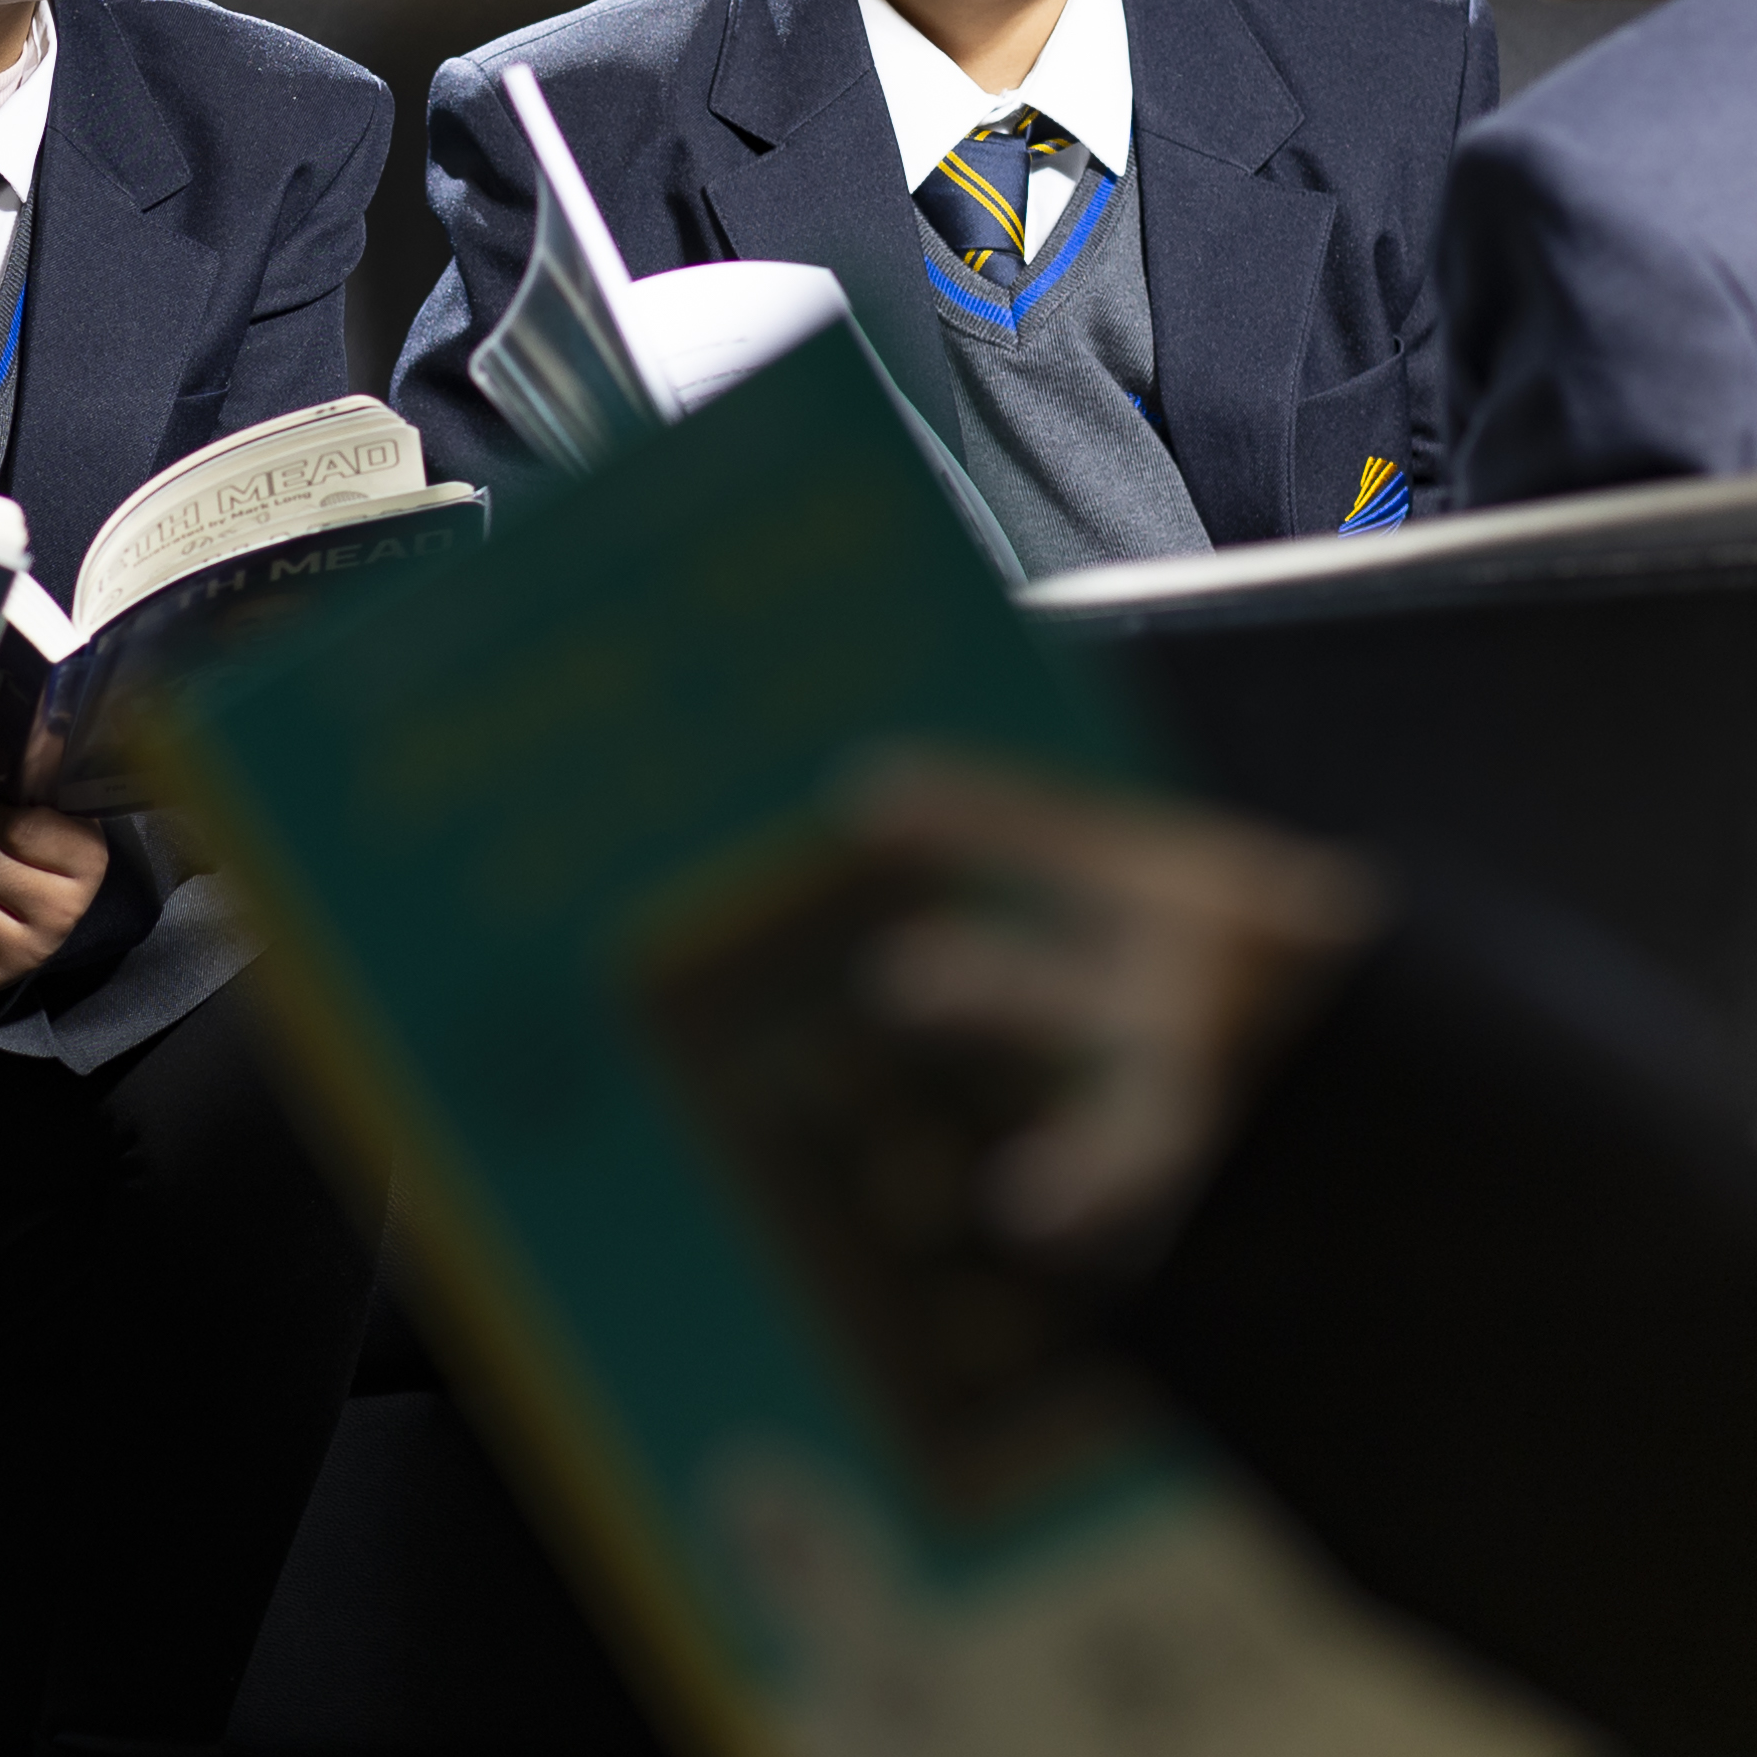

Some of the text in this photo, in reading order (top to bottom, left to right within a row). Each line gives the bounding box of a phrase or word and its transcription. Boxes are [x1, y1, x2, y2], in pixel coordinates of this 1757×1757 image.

[217, 439, 400, 515] MEAD
[208, 517, 226, 529] by
[231, 502, 269, 520] Mark
[274, 491, 312, 507] Long
[269, 528, 455, 583] MEAD
